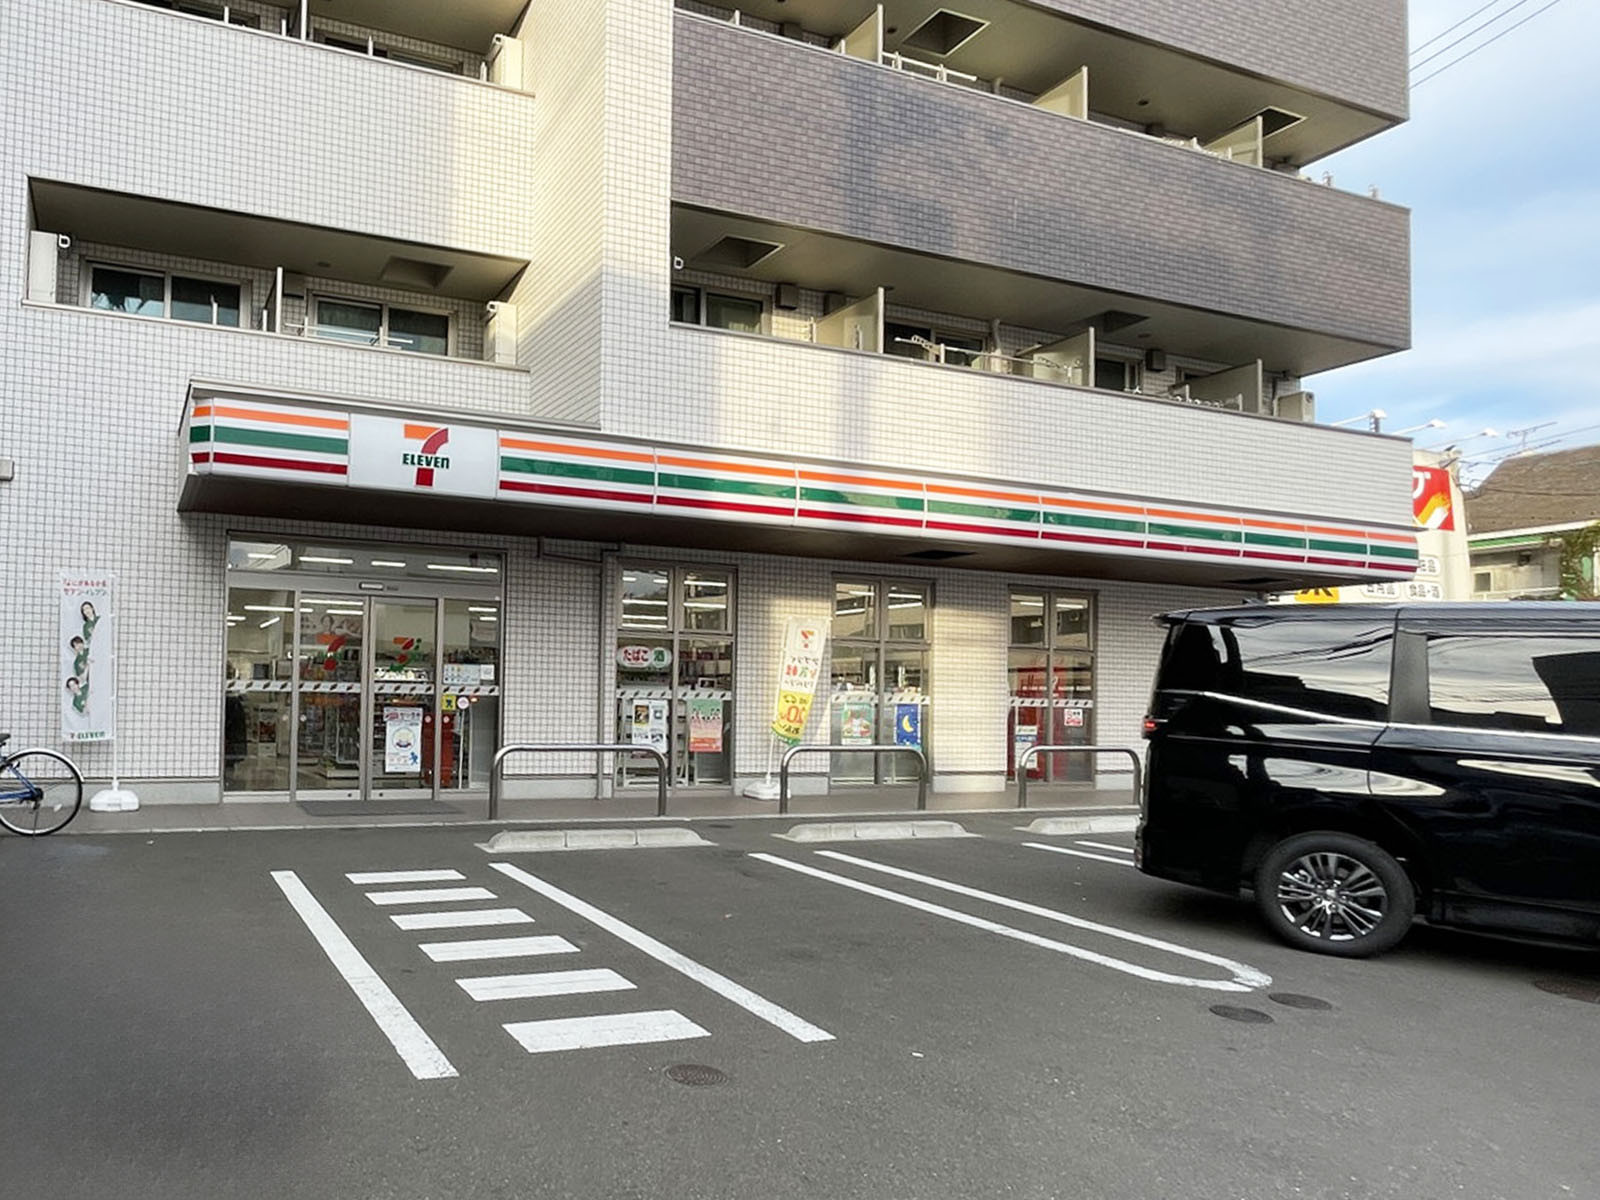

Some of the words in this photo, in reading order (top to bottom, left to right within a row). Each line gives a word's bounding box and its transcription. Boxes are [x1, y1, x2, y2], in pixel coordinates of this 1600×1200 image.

[403, 423, 449, 486] 7
[623, 648, 649, 662] たばこ
